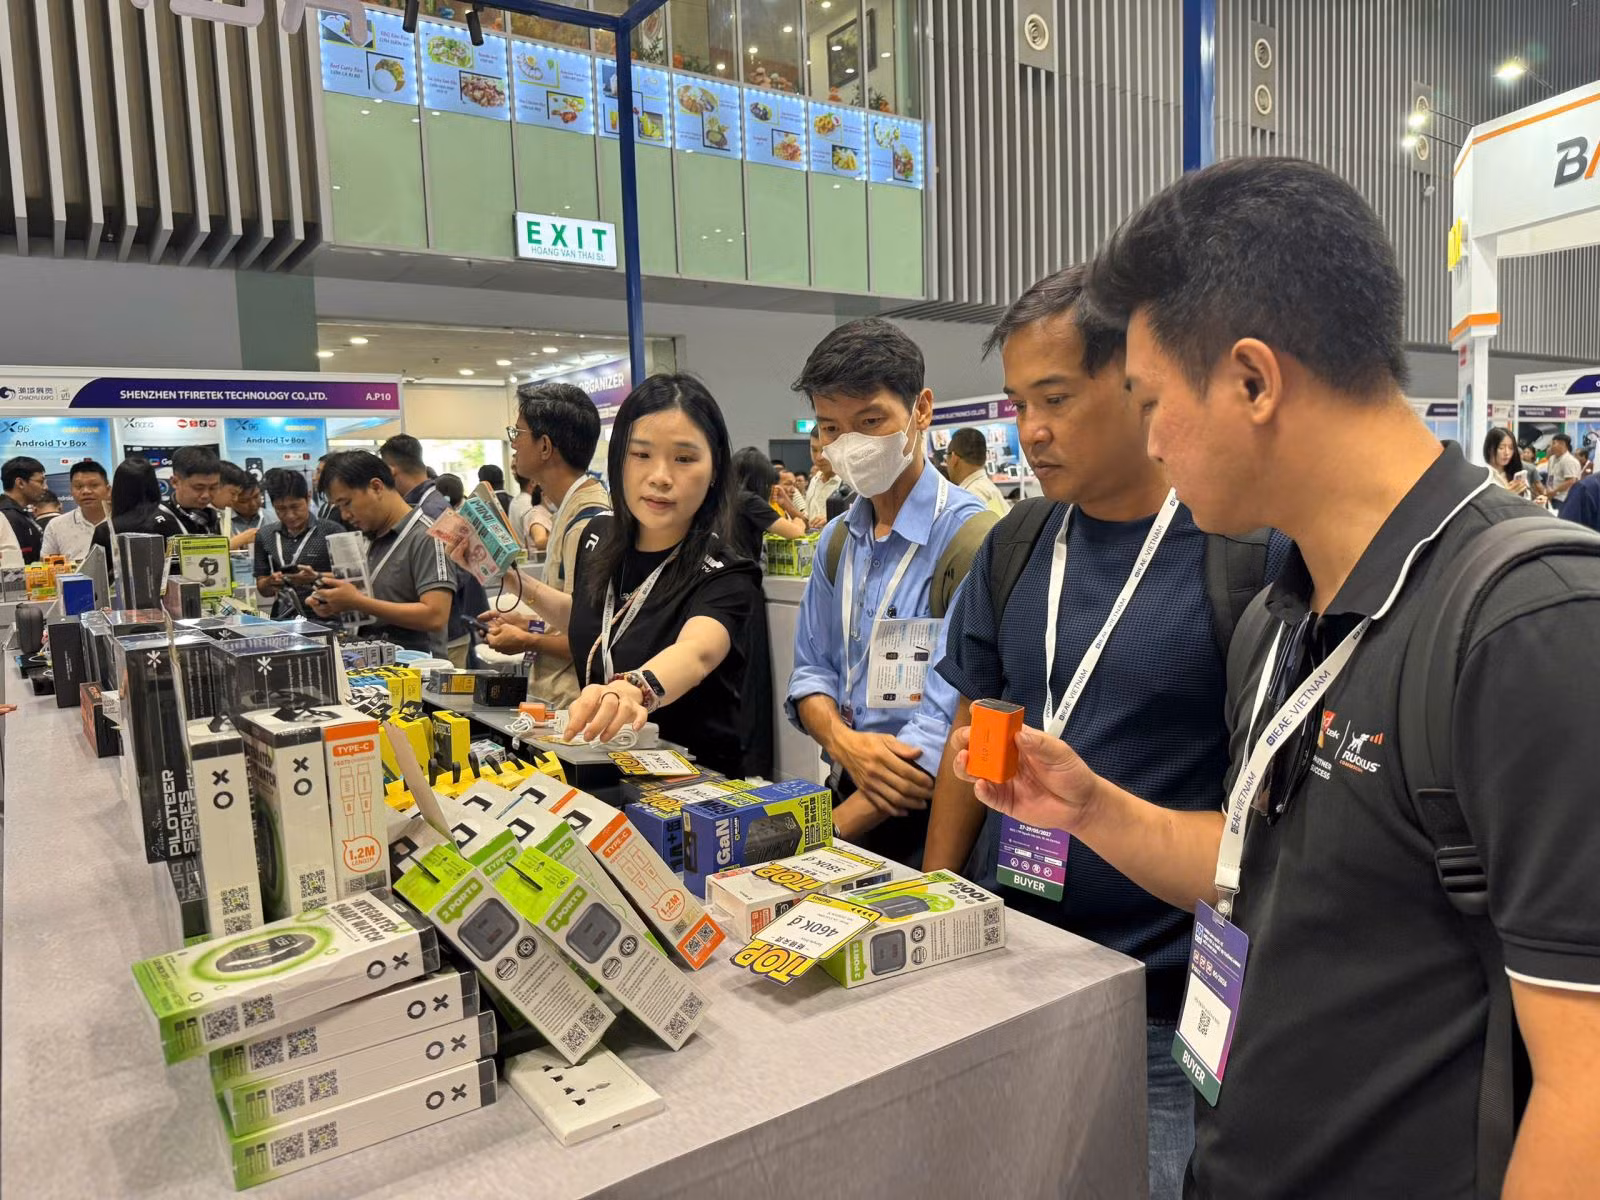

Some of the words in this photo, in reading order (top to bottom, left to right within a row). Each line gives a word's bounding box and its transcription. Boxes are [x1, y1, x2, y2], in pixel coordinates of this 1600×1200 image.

[527, 220, 607, 252] EXIT
[531, 246, 559, 256] HOANG
[560, 248, 576, 258] VAN
[578, 250, 595, 260] THAI
[579, 372, 625, 394] ORGANIZER
[120, 390, 177, 399] SHENZHEN
[178, 391, 224, 400] TFIRETEK
[225, 392, 290, 400] TECHNOLOGY
[366, 392, 391, 401] A.P10
[15, 439, 54, 447] Android
[337, 743, 370, 755] TYPE-C
[1341, 750, 1378, 773] RUCKUS
[162, 769, 182, 856] PILOTEER
[178, 791, 196, 854] SERIES
[348, 845, 376, 861] 1.2M
[604, 829, 630, 856] TYPE-C
[716, 818, 731, 866] GaN
[753, 863, 825, 892] TOP
[812, 858, 846, 874] 380K
[953, 881, 991, 903] 100W
[1013, 874, 1046, 893] BUYER
[448, 882, 481, 913] PORTS
[556, 889, 585, 921] PORTS
[660, 894, 680, 916] 1.2M
[331, 903, 363, 922] SMART
[351, 919, 386, 943] WATCH
[351, 899, 400, 933] INTEGRATED
[800, 919, 840, 938] 460K
[732, 940, 814, 986] TOP
[1181, 1049, 1206, 1086] BUYER
